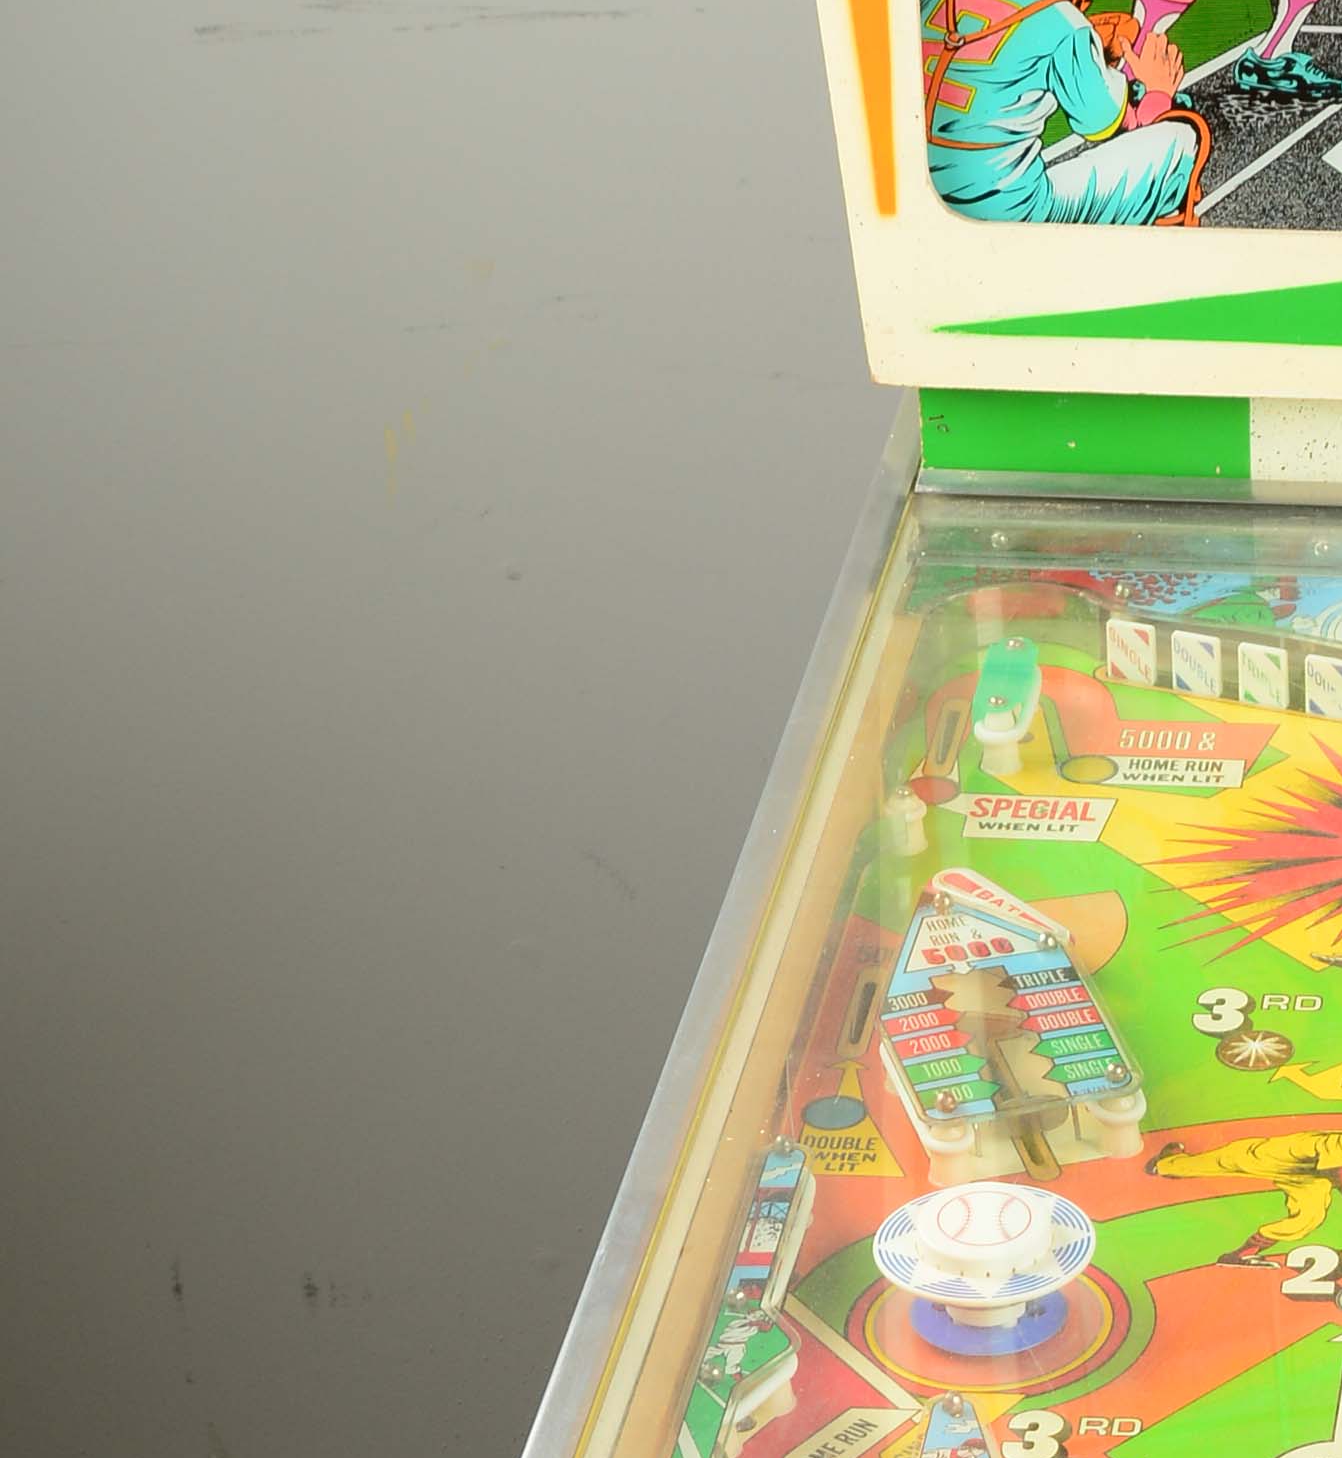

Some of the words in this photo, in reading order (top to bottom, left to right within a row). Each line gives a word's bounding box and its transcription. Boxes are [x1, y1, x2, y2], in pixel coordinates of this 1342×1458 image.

[1119, 728, 1192, 751] 5000
[1198, 731, 1216, 751] &
[1129, 758, 1179, 772] HOME
[1185, 760, 1223, 772] RUN
[1122, 772, 1186, 782] WHEN
[1192, 774, 1225, 783] LIT
[969, 798, 1096, 822] SPECIAL
[978, 822, 1040, 831] WHEN
[1047, 823, 1080, 832] LIT
[975, 887, 1022, 913] BAT
[929, 931, 961, 947] RUN
[921, 937, 1015, 965] 5000
[1014, 969, 1070, 988] TRIPLE
[888, 992, 928, 1012] 3000
[1025, 987, 1082, 1010] DOUBLE
[899, 1012, 940, 1031] 2000
[1039, 1008, 1096, 1030] DOUBLE
[1191, 987, 1323, 1035] 3RD
[909, 1033, 951, 1055] 2000
[1051, 1034, 1105, 1055] SINGLE
[922, 1058, 962, 1079] 1000
[804, 1135, 878, 1151] DOUBLE
[814, 1152, 876, 1162] WHEN
[823, 1161, 861, 1172] LIT
[835, 1418, 878, 1446] RUN
